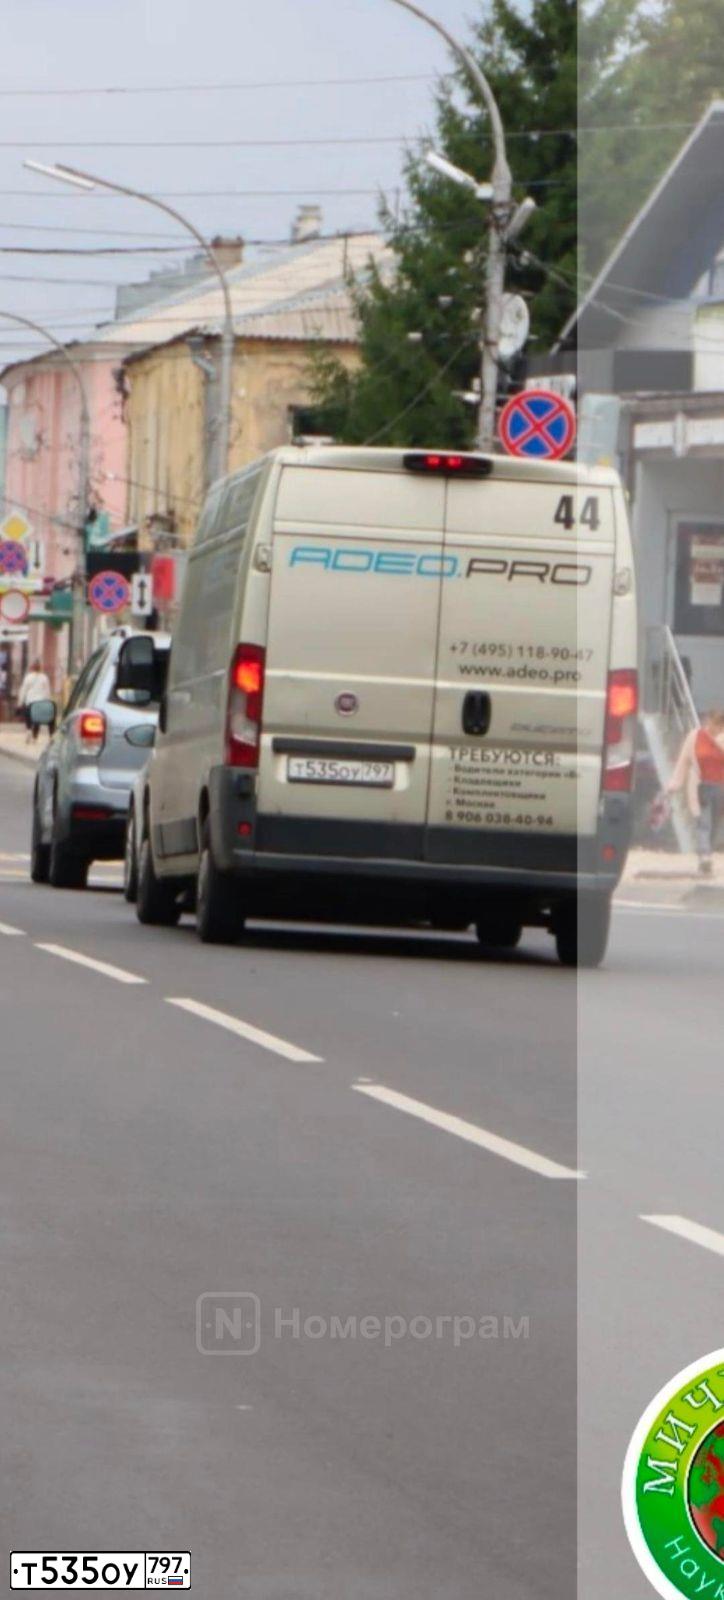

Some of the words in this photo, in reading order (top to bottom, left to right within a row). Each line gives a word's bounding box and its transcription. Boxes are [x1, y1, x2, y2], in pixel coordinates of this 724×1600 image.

[553, 494, 600, 532] 44
[289, 547, 592, 586] ADEO.PRO
[450, 642, 468, 655] +7
[472, 643, 513, 659] (495)
[517, 645, 594, 662] 118-90-47
[459, 664, 582, 683] www.adeo.pro
[450, 748, 560, 766] ТРЕБУЮТСЯ:
[365, 763, 390, 777] 797
